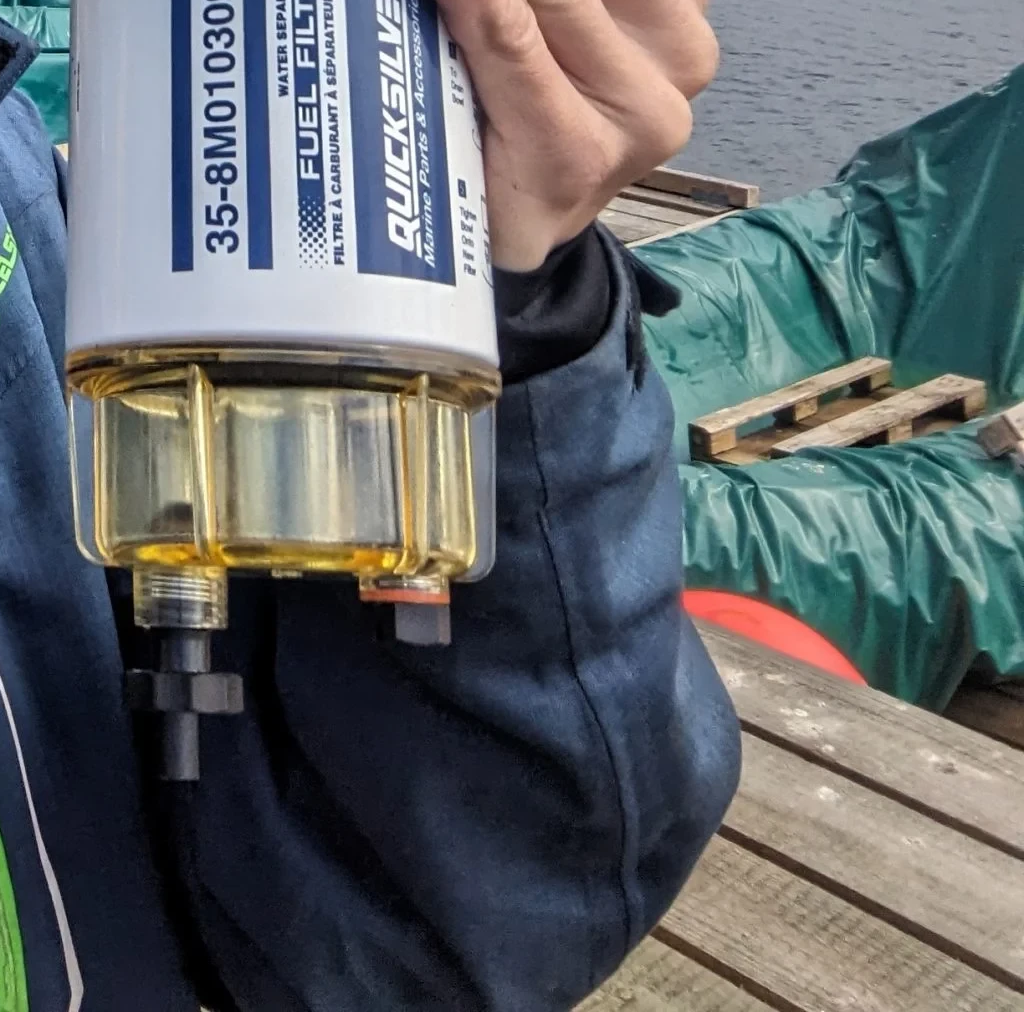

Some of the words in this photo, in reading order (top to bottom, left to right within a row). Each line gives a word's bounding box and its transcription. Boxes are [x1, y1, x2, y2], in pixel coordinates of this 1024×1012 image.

[276, 46, 289, 98] WATER
[324, 90, 337, 100] À
[297, 83, 320, 180] FUEL
[416, 111, 427, 128] &
[328, 103, 342, 195] CARBURANT
[419, 131, 431, 188] Parts
[329, 199, 343, 209] À
[420, 192, 436, 268] Marine
[332, 213, 345, 266] FILTRE
